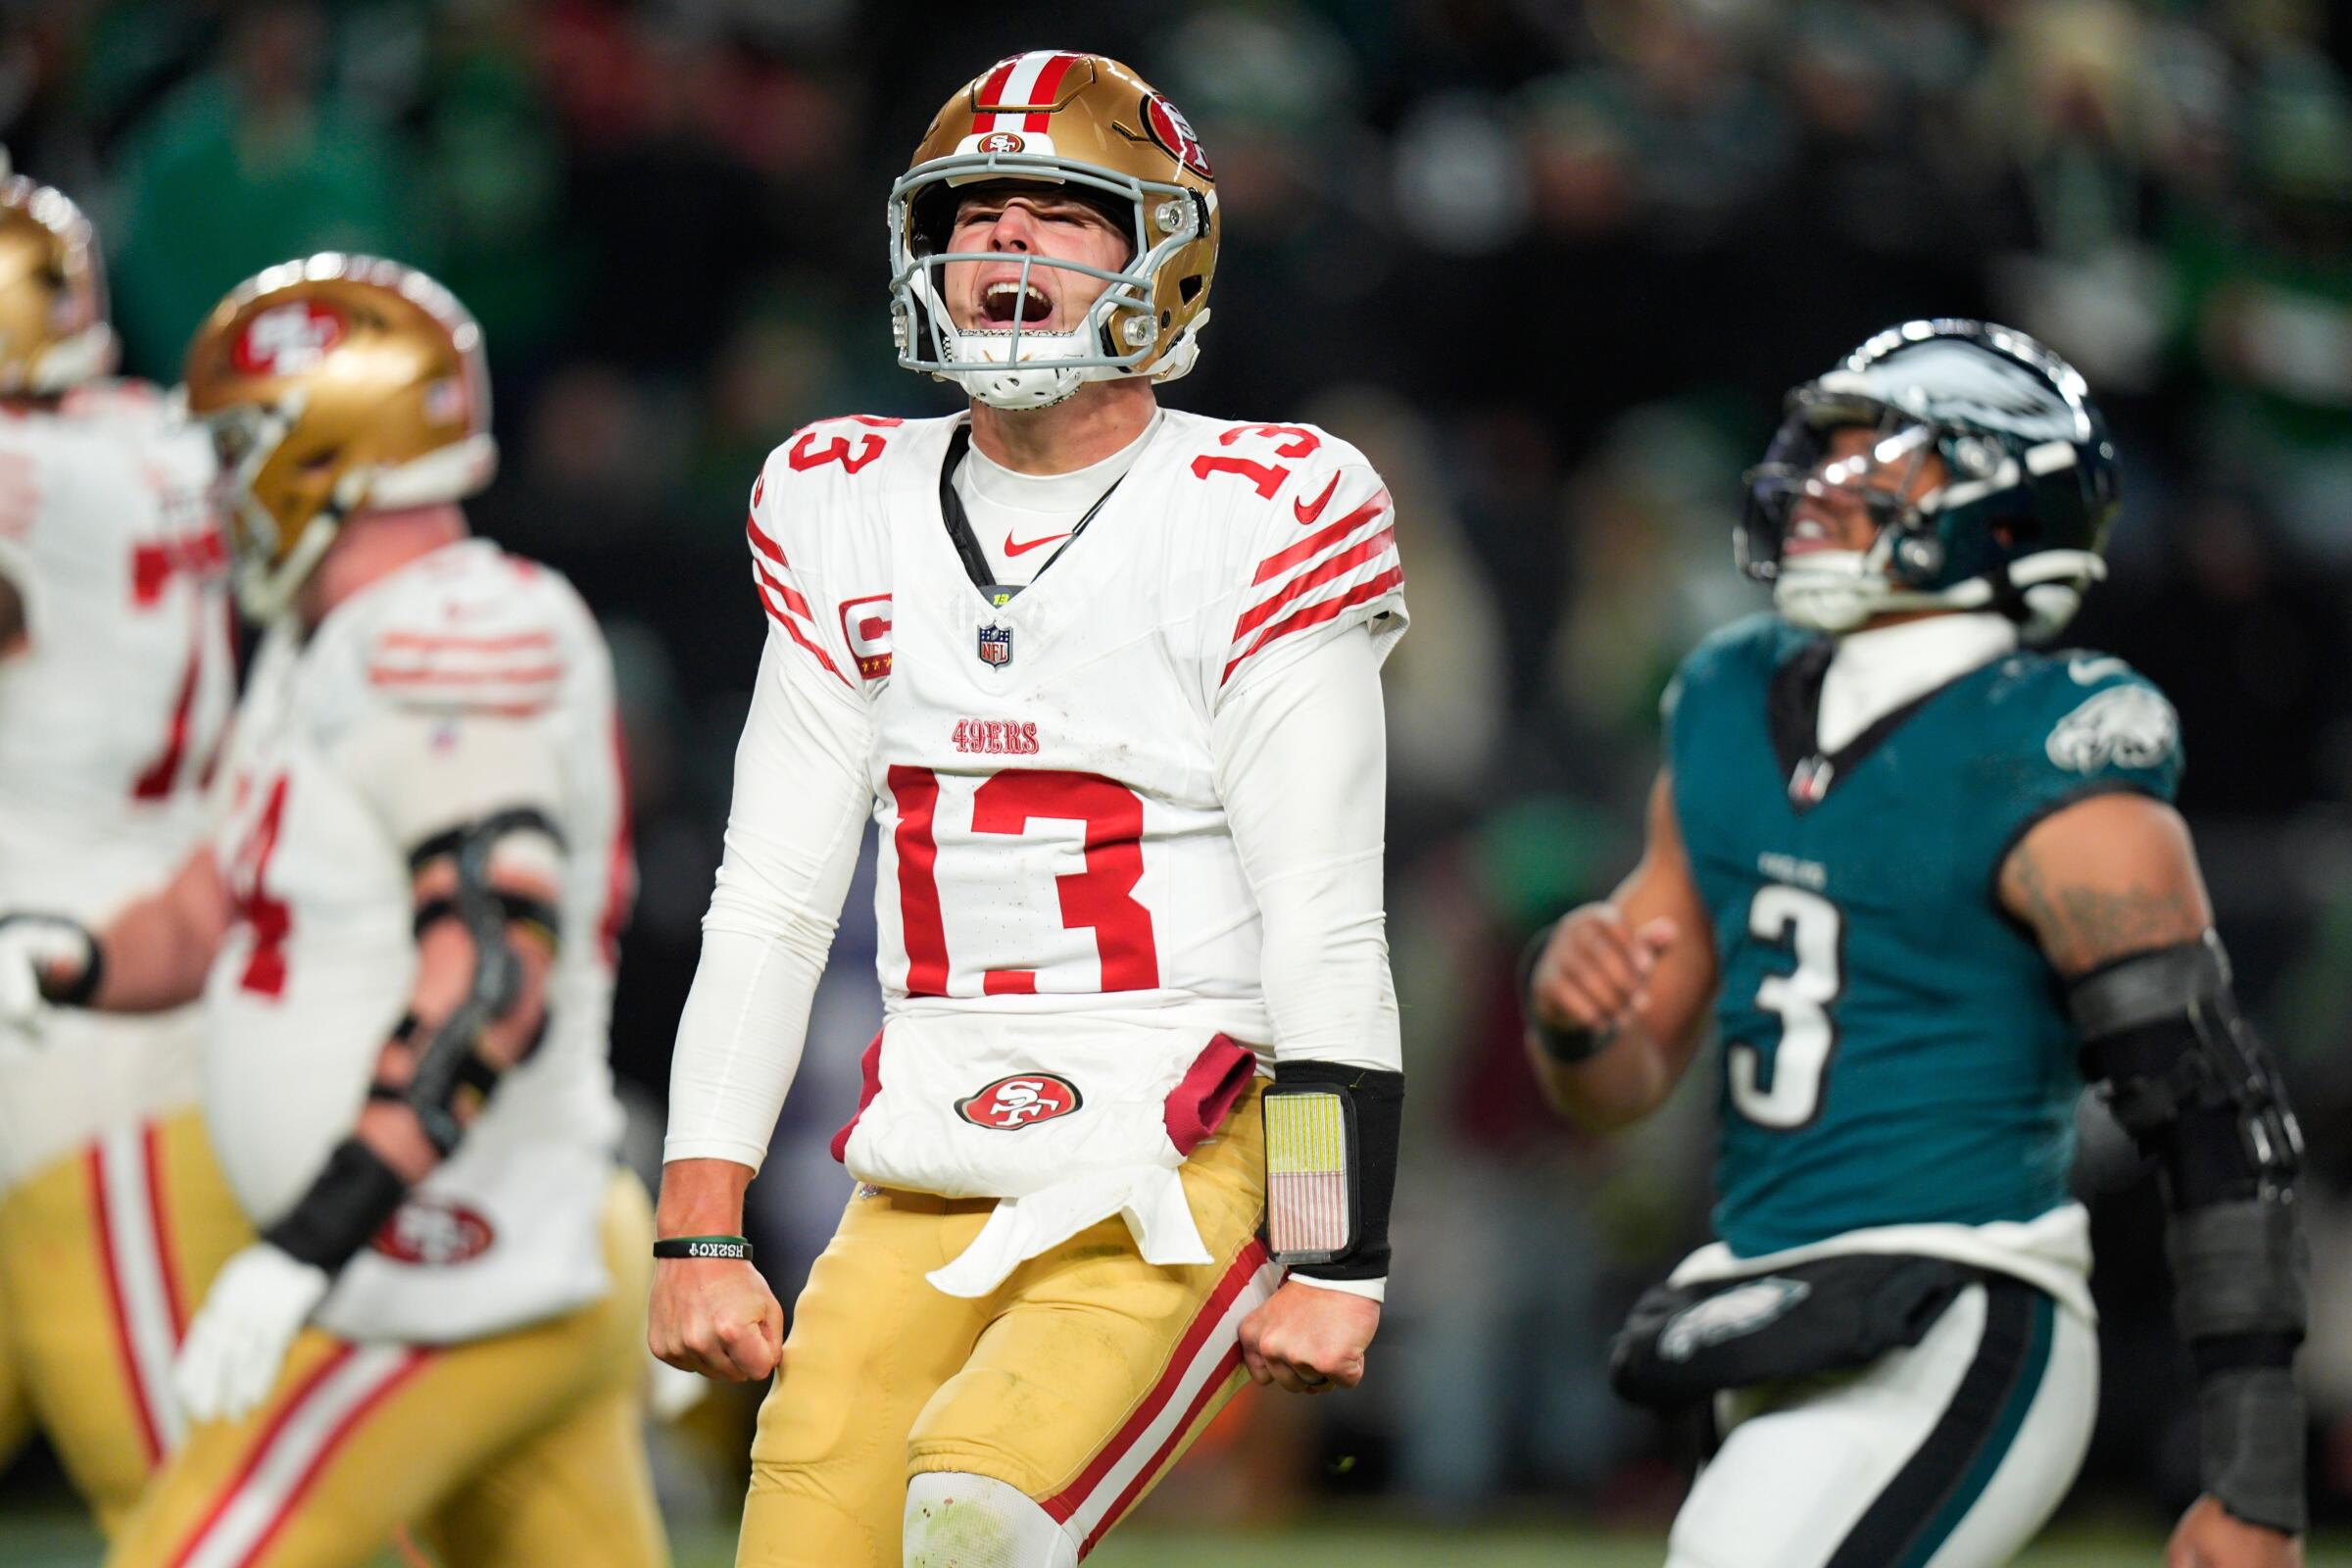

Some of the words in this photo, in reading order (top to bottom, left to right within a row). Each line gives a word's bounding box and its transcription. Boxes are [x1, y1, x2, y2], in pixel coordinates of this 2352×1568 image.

[1190, 423, 1322, 501] 13
[982, 643, 1007, 662] NFL
[952, 718, 1040, 755] 49ERS
[887, 764, 1160, 999] 13
[1728, 884, 1842, 1130] 3
[990, 1080, 1059, 1126] SF
